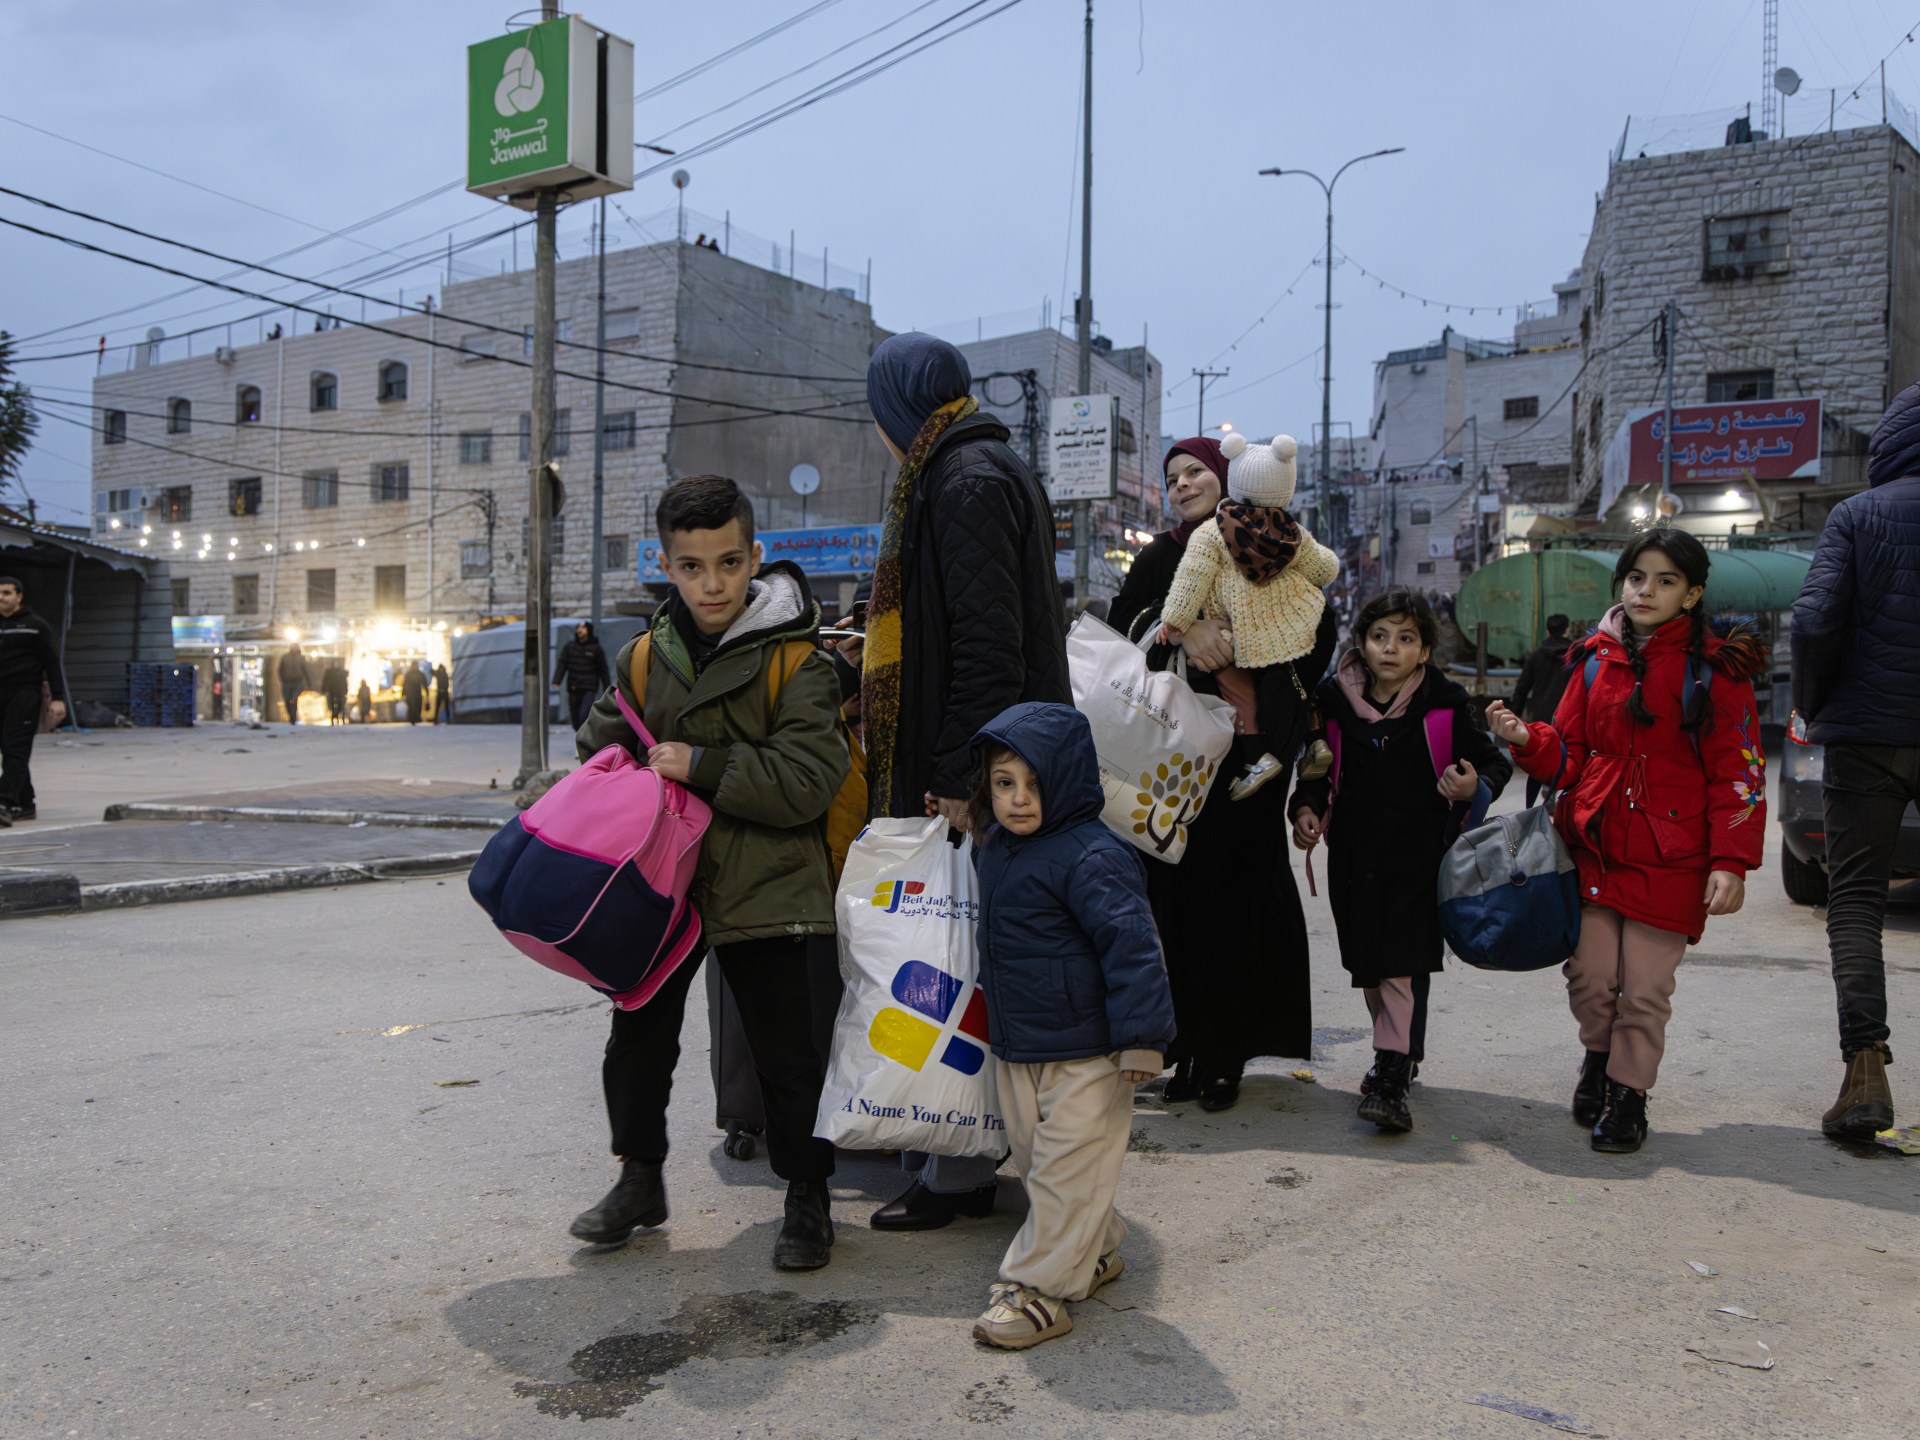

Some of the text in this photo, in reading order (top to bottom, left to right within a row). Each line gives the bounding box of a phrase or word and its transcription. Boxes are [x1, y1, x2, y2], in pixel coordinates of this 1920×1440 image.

[490, 118, 548, 146] جوال
[490, 135, 548, 165] Jawwal
[1717, 414, 1731, 435] و
[1733, 408, 1805, 429] ملحمة
[1701, 446, 1731, 464] بن
[1734, 435, 1794, 462] طارق
[902, 894, 923, 904] Beit
[842, 1096, 1006, 1131] A Name You Can Tru
